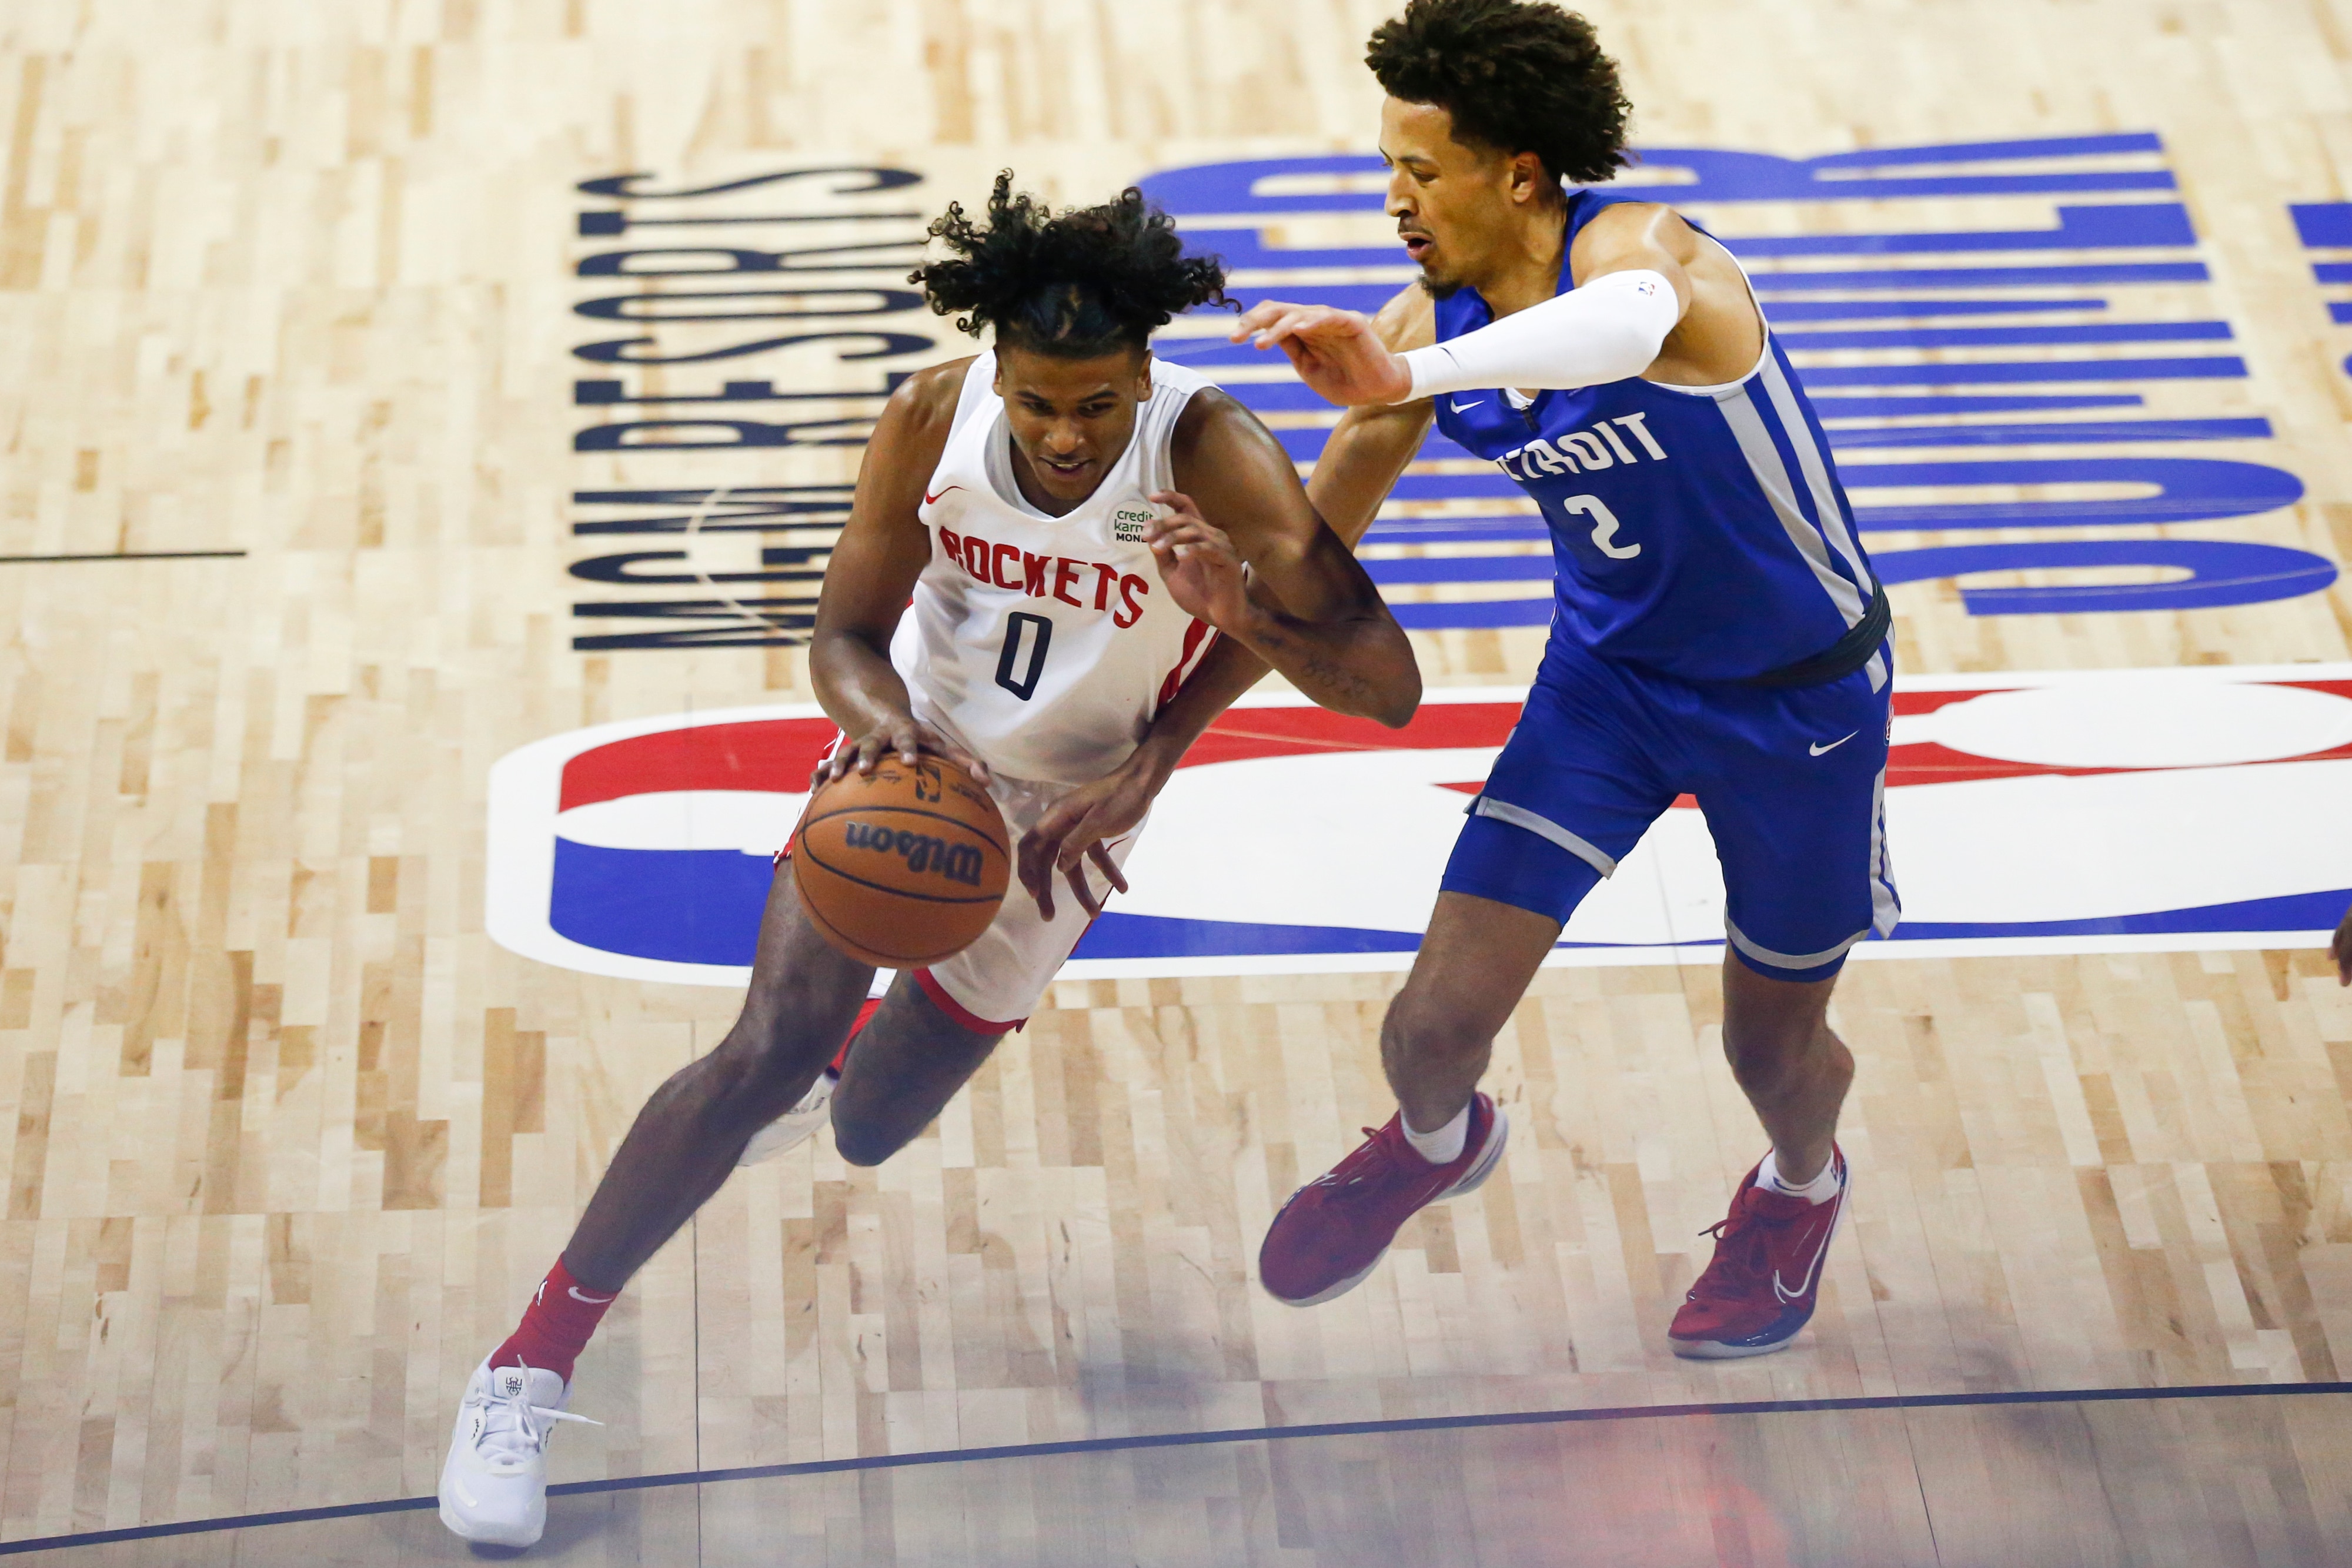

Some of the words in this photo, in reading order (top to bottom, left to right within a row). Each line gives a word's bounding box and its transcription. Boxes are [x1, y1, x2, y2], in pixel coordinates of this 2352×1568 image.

[572, 166, 937, 452] RESORTS
[1496, 412, 1668, 481] ETROIT
[1114, 519, 1144, 533] karm
[1116, 533, 1148, 543] MON
[1117, 510, 1154, 522] credit
[1563, 494, 1642, 559] 2
[569, 484, 856, 650] MGM
[939, 526, 1150, 629] ROCKETS
[995, 611, 1053, 701] 0
[845, 821, 983, 887] Wilson
